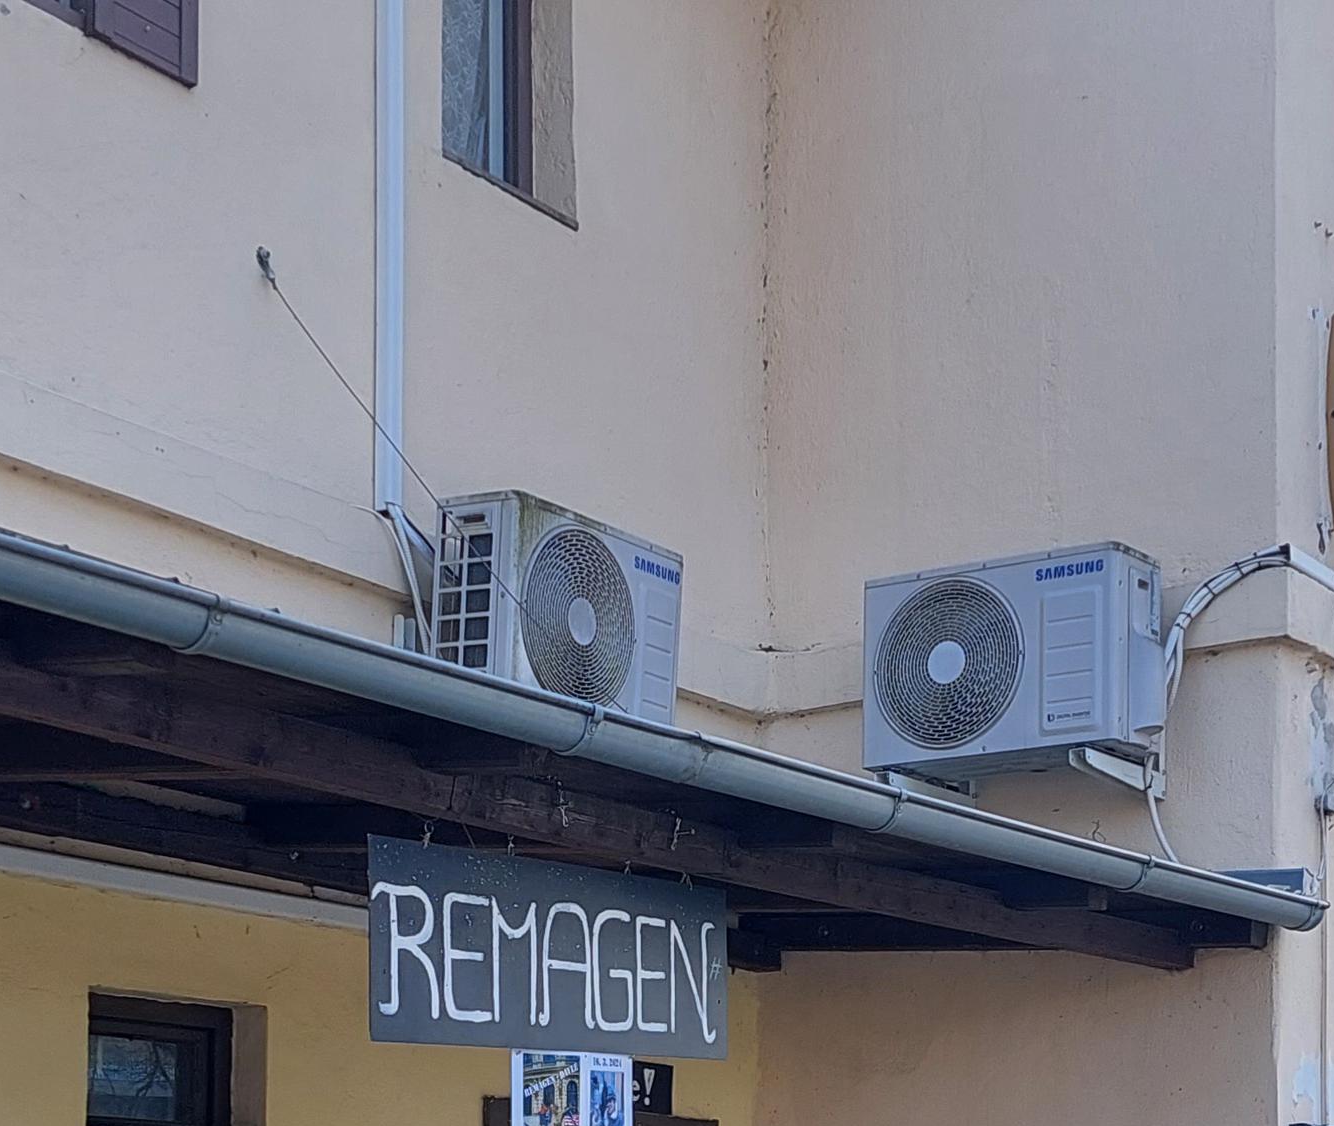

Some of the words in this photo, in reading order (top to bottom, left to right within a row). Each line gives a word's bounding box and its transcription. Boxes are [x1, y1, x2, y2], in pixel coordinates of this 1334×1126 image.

[634, 555, 680, 585] SAMSUNG
[1035, 558, 1104, 582] SAMSUNG
[370, 880, 717, 1045] REMAGEN
